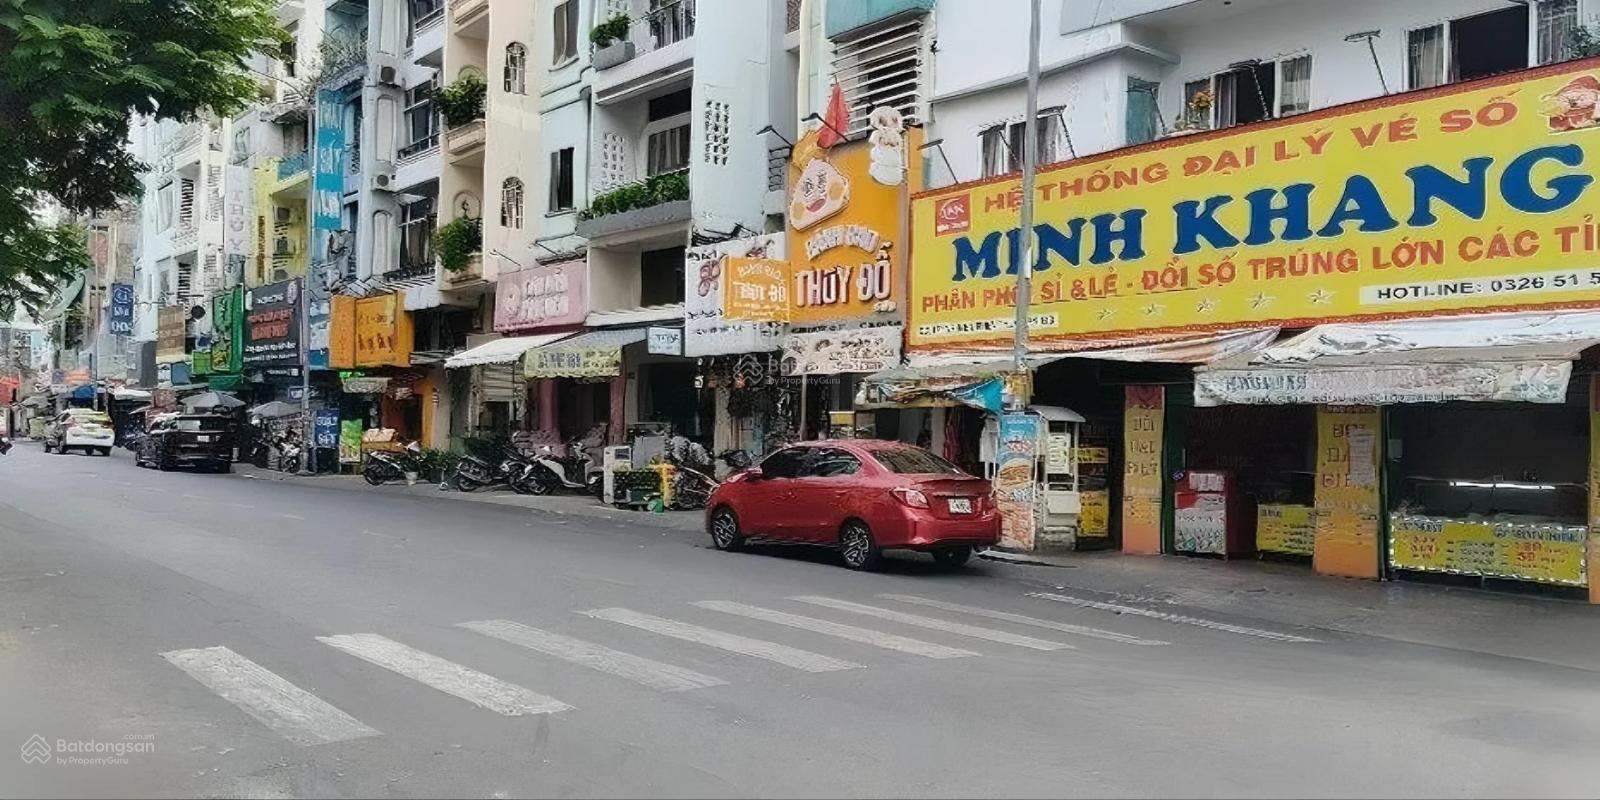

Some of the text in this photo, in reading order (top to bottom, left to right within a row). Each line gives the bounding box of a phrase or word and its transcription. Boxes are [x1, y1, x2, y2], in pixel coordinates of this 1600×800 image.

[984, 186, 1025, 213] HỆ
[1036, 163, 1169, 202] THỐNG
[1183, 146, 1256, 177] ĐẠI
[1274, 128, 1334, 163] LÝ
[1351, 112, 1418, 149] VÉ
[1440, 88, 1522, 133] SỐ
[952, 207, 1148, 282] MINH
[1172, 143, 1595, 256] KHANG
[856, 241, 893, 302] ĐỖ
[922, 288, 976, 313] PHÂN
[1041, 272, 1062, 301] SỈ
[1141, 256, 1189, 290] ĐỔI
[1198, 251, 1239, 286] SỐ
[1248, 247, 1359, 280] TRÚNG
[1372, 236, 1444, 271] LỚN
[1458, 225, 1540, 263] CÁC
[1553, 213, 1600, 254] TỈ
[1377, 281, 1483, 300] HOTLINE:
[1490, 276, 1544, 293] 0326
[1553, 273, 1578, 288] 51
